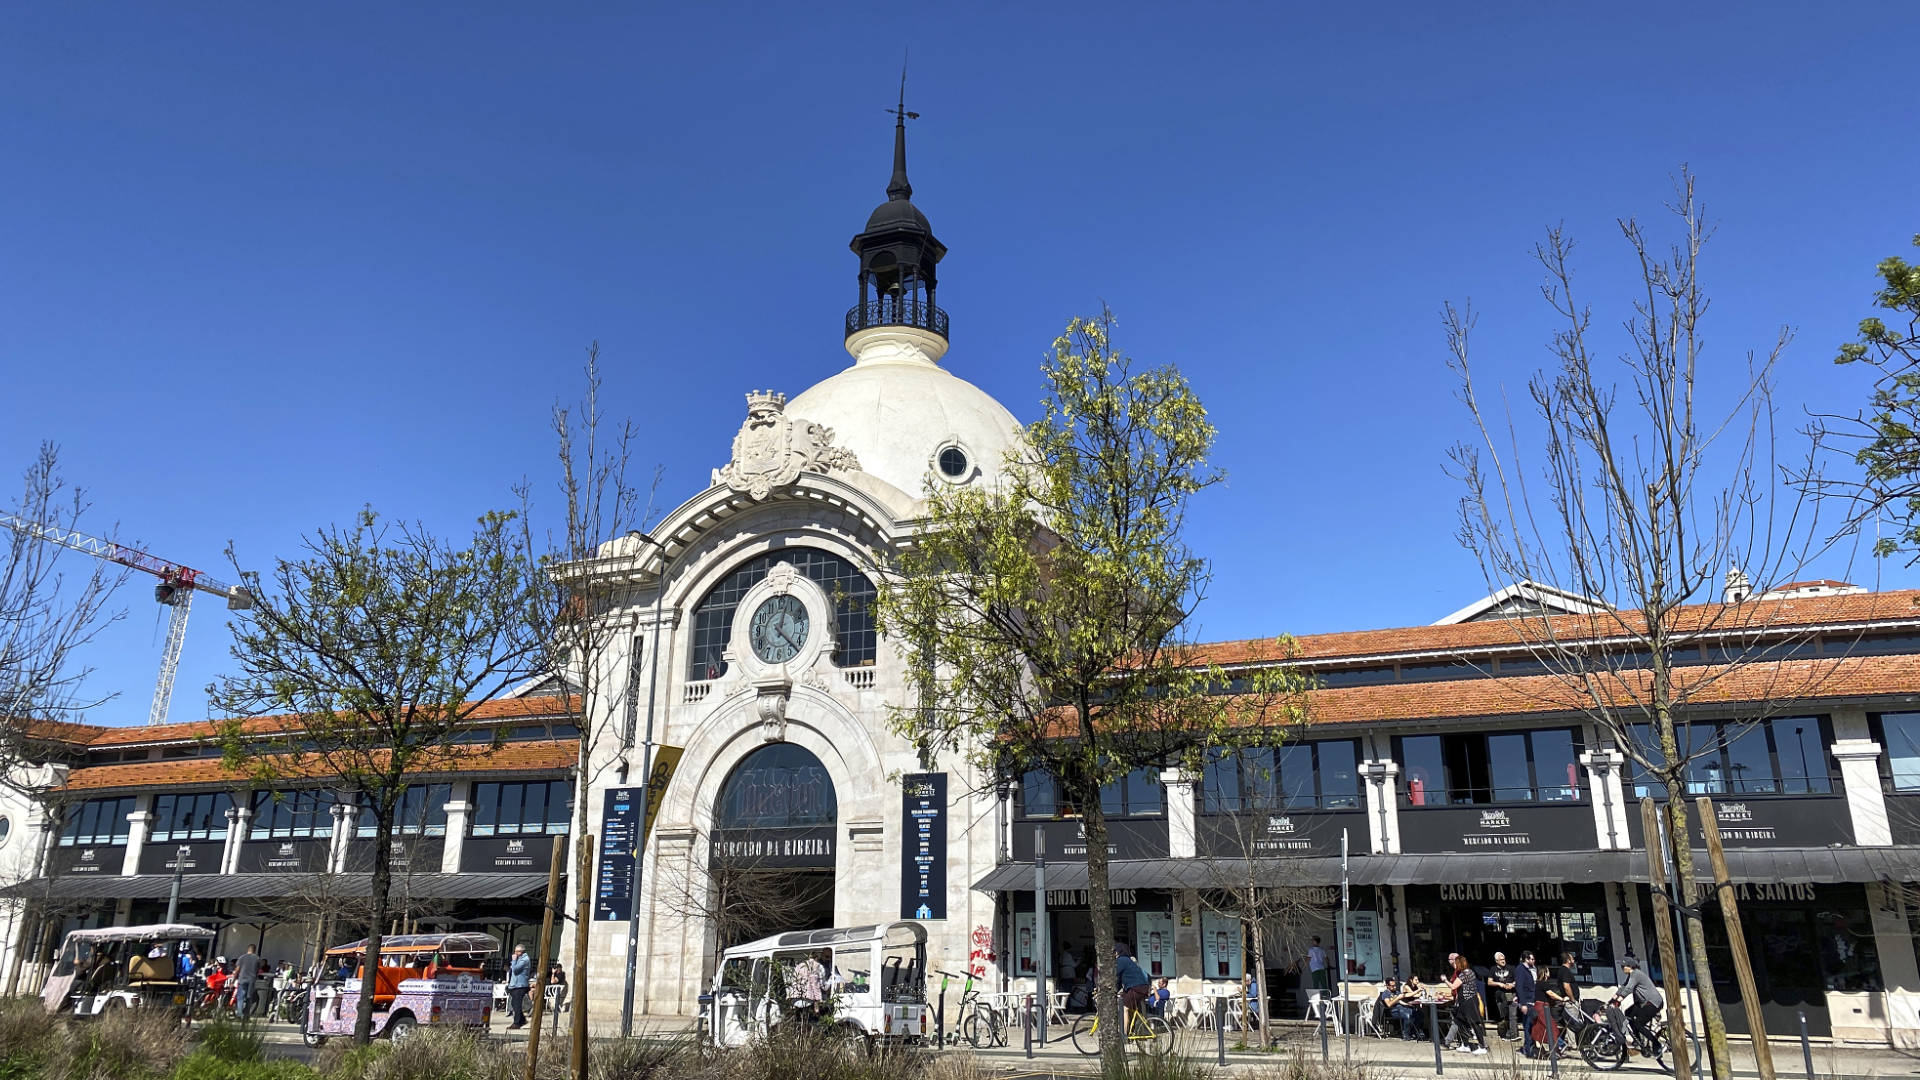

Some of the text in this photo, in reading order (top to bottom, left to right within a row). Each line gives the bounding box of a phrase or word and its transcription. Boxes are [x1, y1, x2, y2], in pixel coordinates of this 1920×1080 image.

[768, 602, 774, 614] 11
[790, 601, 793, 611] 1
[759, 613, 766, 624] 10
[756, 626, 760, 636] 9
[800, 622, 804, 632] 3
[758, 639, 762, 650] 8
[796, 636, 801, 646] 4
[766, 648, 771, 660] 7
[777, 648, 781, 660] 6
[787, 646, 792, 656] 5
[714, 840, 830, 858] MERCADO DA RIBEIRA
[1440, 882, 1565, 900] CACAU DA RIBEIRA
[1756, 882, 1816, 900] SANTOS
[1047, 890, 1076, 906] GINJA
